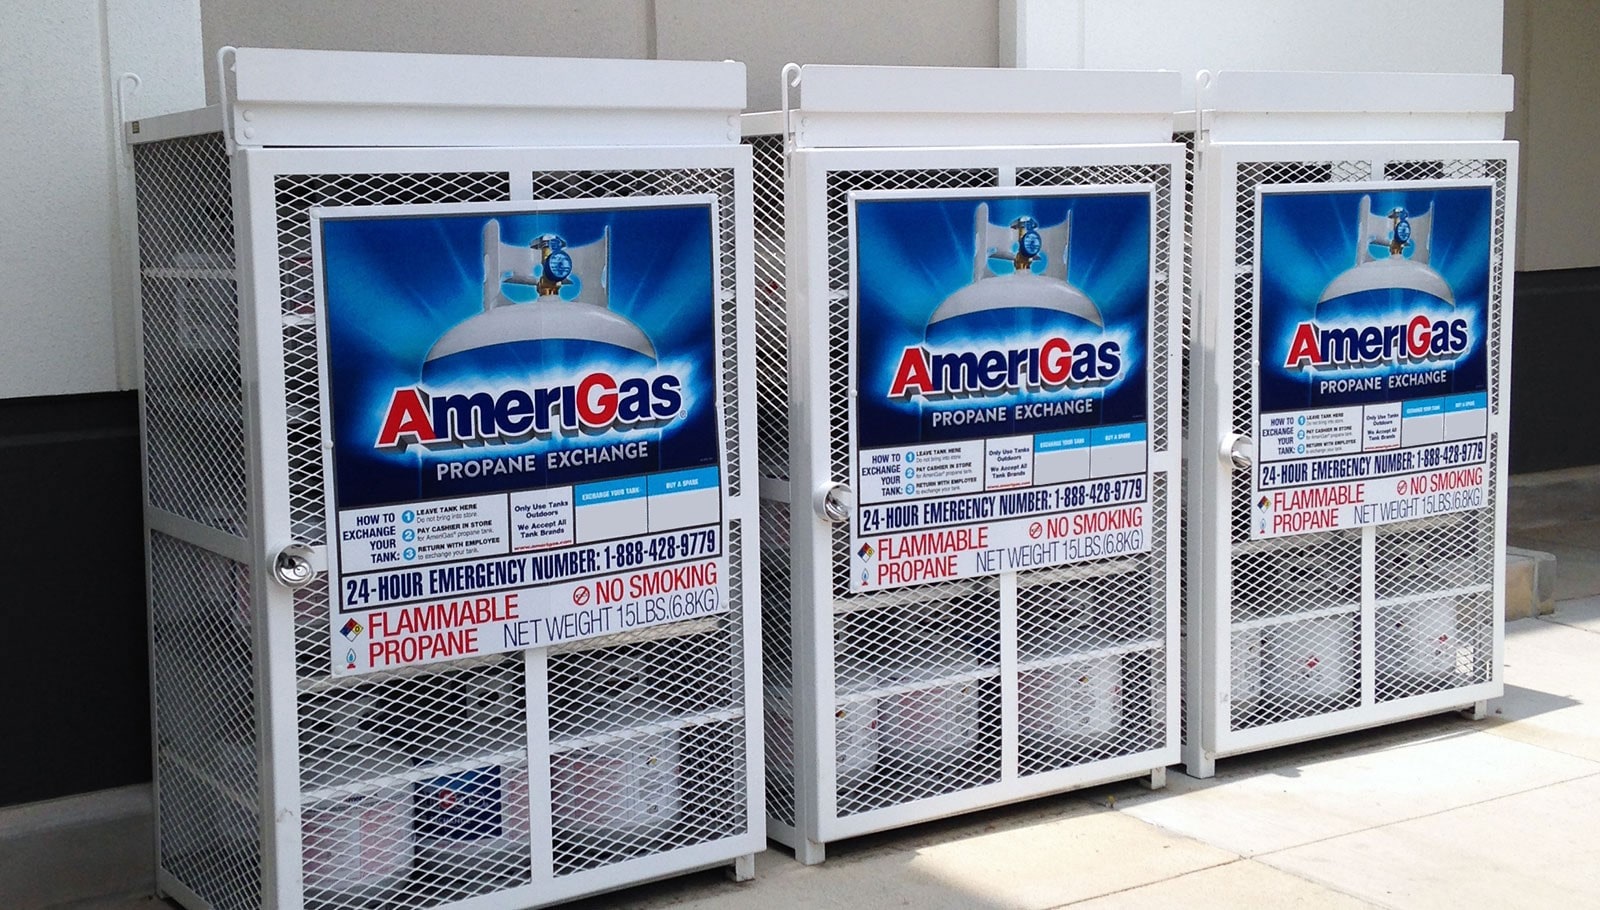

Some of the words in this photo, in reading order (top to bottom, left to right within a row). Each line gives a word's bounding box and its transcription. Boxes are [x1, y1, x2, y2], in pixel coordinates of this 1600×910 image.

[1285, 315, 1468, 367] AmeriGas
[889, 337, 1121, 397] AmeriGas
[1320, 377, 1382, 394] PROPANE
[1388, 370, 1447, 389] EXCHANGE
[375, 371, 682, 446] AmeriGas
[932, 406, 1006, 427] PROPANE
[1015, 399, 1093, 421] EXCHANGE
[1271, 418, 1285, 426] HOW
[1287, 417, 1294, 425] TO
[1262, 427, 1294, 437] EXCHANGE
[1278, 437, 1294, 445] YOUR
[1278, 447, 1295, 455] TANK:
[437, 454, 535, 481] PROPANE
[547, 441, 648, 469] EXCHANGE
[872, 454, 889, 464] HOW
[1262, 463, 1308, 486] 24-HOUR
[1312, 455, 1371, 481] EMERGENCY
[1374, 451, 1415, 474] NUMBER:
[1417, 441, 1483, 468] 1-888-428-9779
[862, 465, 900, 476] EXCHANGE
[881, 476, 900, 485] YOUR
[951, 477, 977, 485] EMPLOYEE
[1410, 475, 1427, 495] NO
[1430, 467, 1483, 493] SMOKING
[881, 487, 903, 497] TANK:
[1274, 483, 1365, 512] FLAMMABLE
[417, 507, 438, 515] LEAVE
[549, 500, 568, 508] Tanks
[863, 504, 918, 532] 24-HOUR
[924, 496, 996, 524] EMERGENCY
[999, 490, 1052, 516] NUMBER:
[1055, 478, 1142, 509] 1-888-428-9779
[1354, 503, 1378, 524] NET
[1380, 497, 1420, 521] WEIGHT
[357, 514, 379, 526] HOW
[383, 513, 395, 523] TO
[526, 510, 558, 519] Outdoors
[1273, 508, 1339, 534] PROPANE
[432, 523, 460, 532] CASHIER
[531, 521, 556, 530] Accept
[1047, 516, 1069, 539] NO
[1073, 506, 1142, 536] SMOKING
[343, 526, 396, 541] EXCHANGE
[458, 529, 480, 539] propane
[540, 528, 564, 536] Brands
[370, 539, 396, 550] YOUR
[418, 544, 444, 552] RETURN
[465, 537, 500, 546] EMPLOYEE
[878, 526, 988, 561] FLAMMABLE
[371, 552, 400, 563] TANK:
[425, 551, 452, 560] exchange
[976, 549, 1005, 573] NET
[1008, 541, 1060, 569] WEIGHT
[347, 572, 423, 605] 24-HOUR
[429, 558, 527, 594] EMERGENCY
[531, 549, 601, 586] NUMBER:
[603, 529, 715, 569] 1-888-428-9779
[878, 555, 958, 585] PROPANE
[596, 578, 624, 605] NO
[629, 562, 717, 599] SMOKING
[368, 594, 519, 639] FLAMMABLE
[504, 619, 542, 648] NET
[546, 606, 613, 641] WEIGHT
[369, 628, 479, 668] PROPANE
